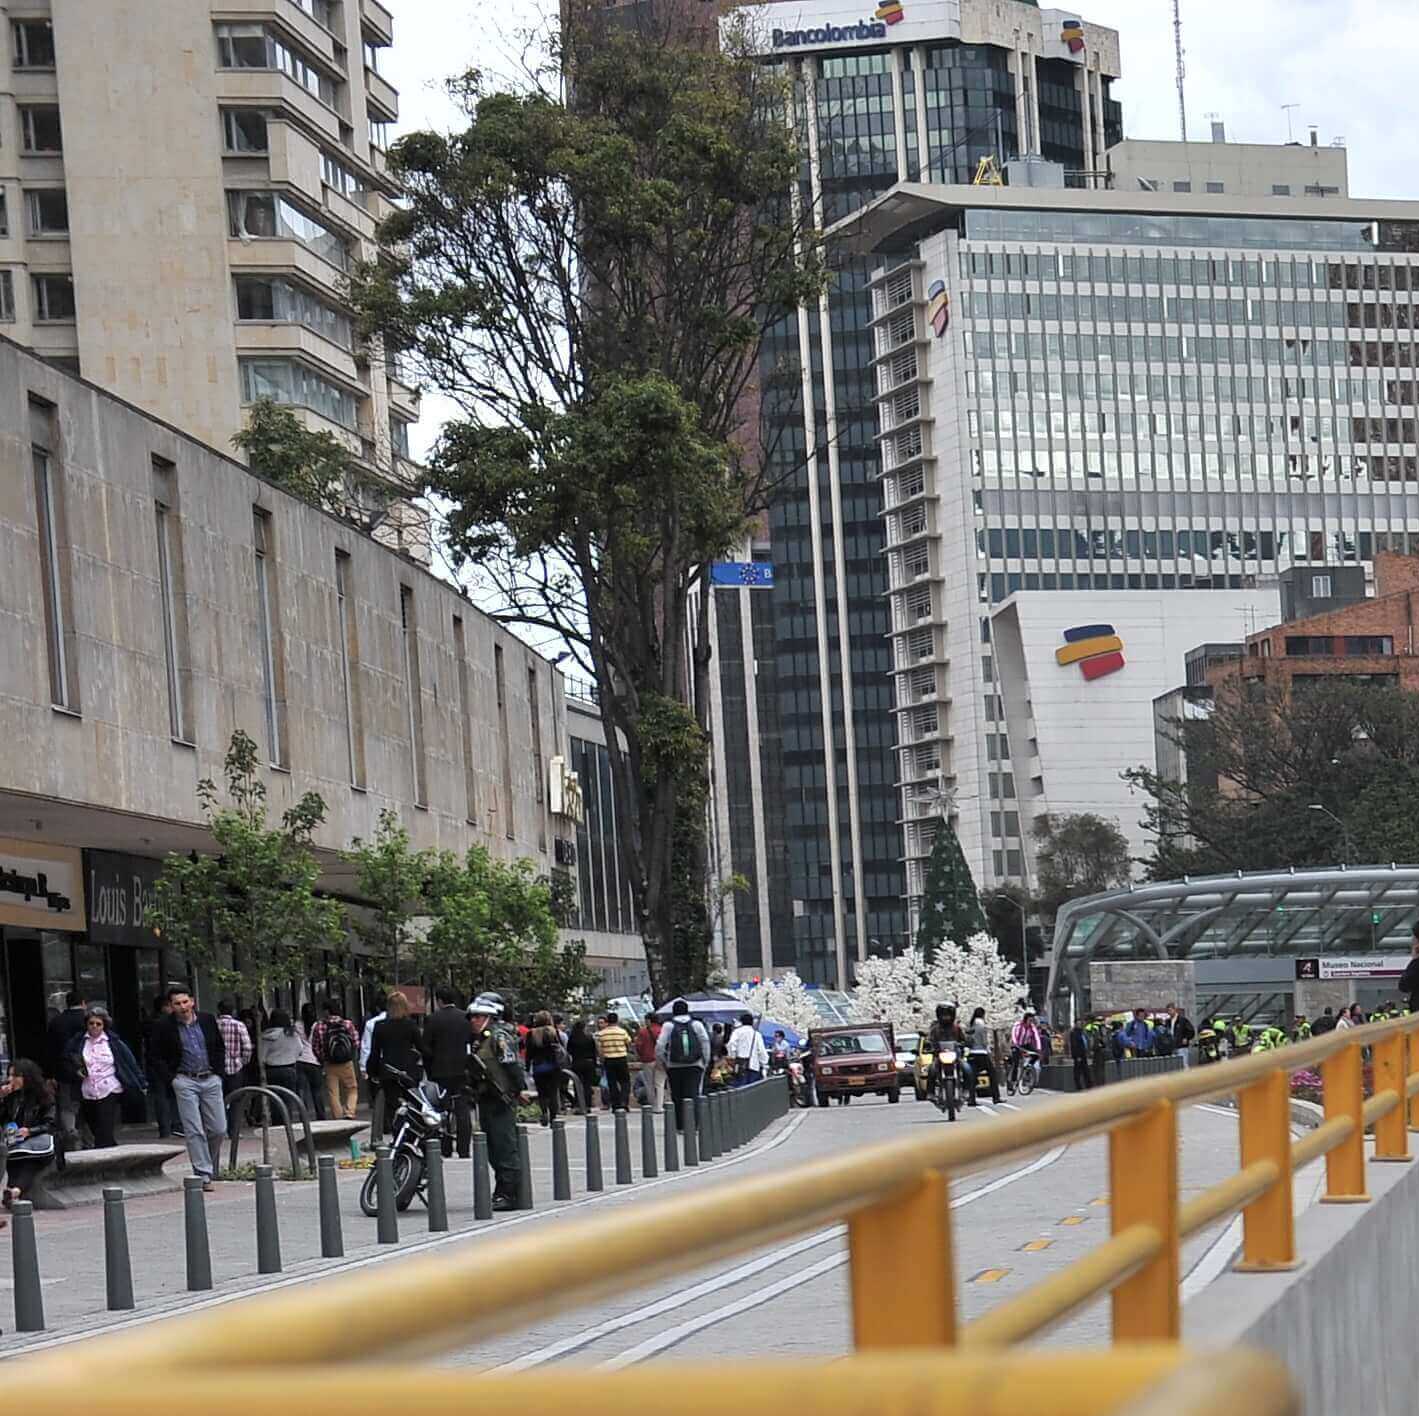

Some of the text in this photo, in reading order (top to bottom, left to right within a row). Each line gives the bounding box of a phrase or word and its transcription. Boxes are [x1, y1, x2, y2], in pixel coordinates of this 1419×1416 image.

[772, 17, 886, 48] Bancolombia
[91, 869, 127, 927] Louis
[1322, 959, 1384, 970] Museo Nacional
